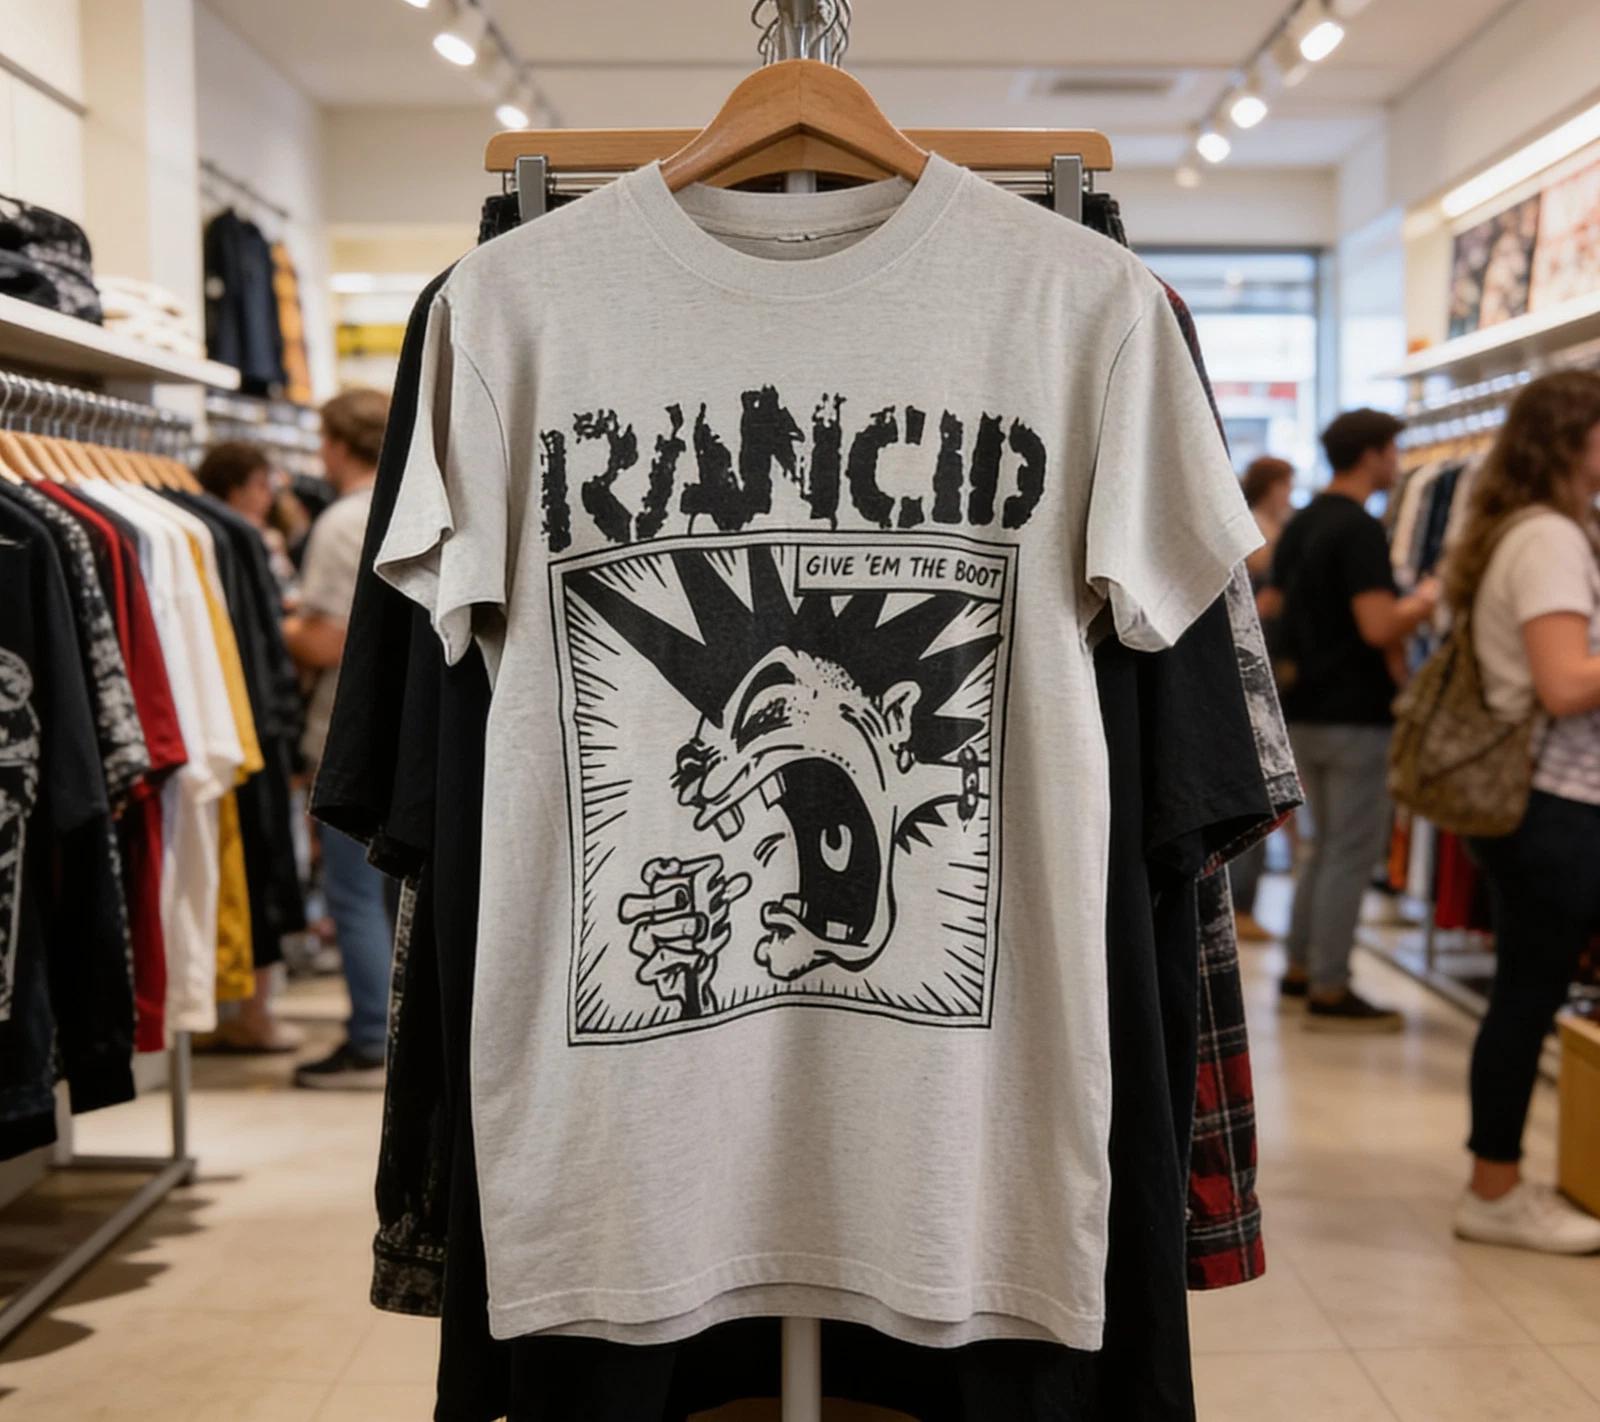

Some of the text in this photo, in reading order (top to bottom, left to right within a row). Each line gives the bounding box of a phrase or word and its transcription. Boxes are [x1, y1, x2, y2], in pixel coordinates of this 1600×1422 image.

[540, 384, 1047, 552] RANCID
[806, 553, 1002, 589] GIVE 'EM THE BOOT
